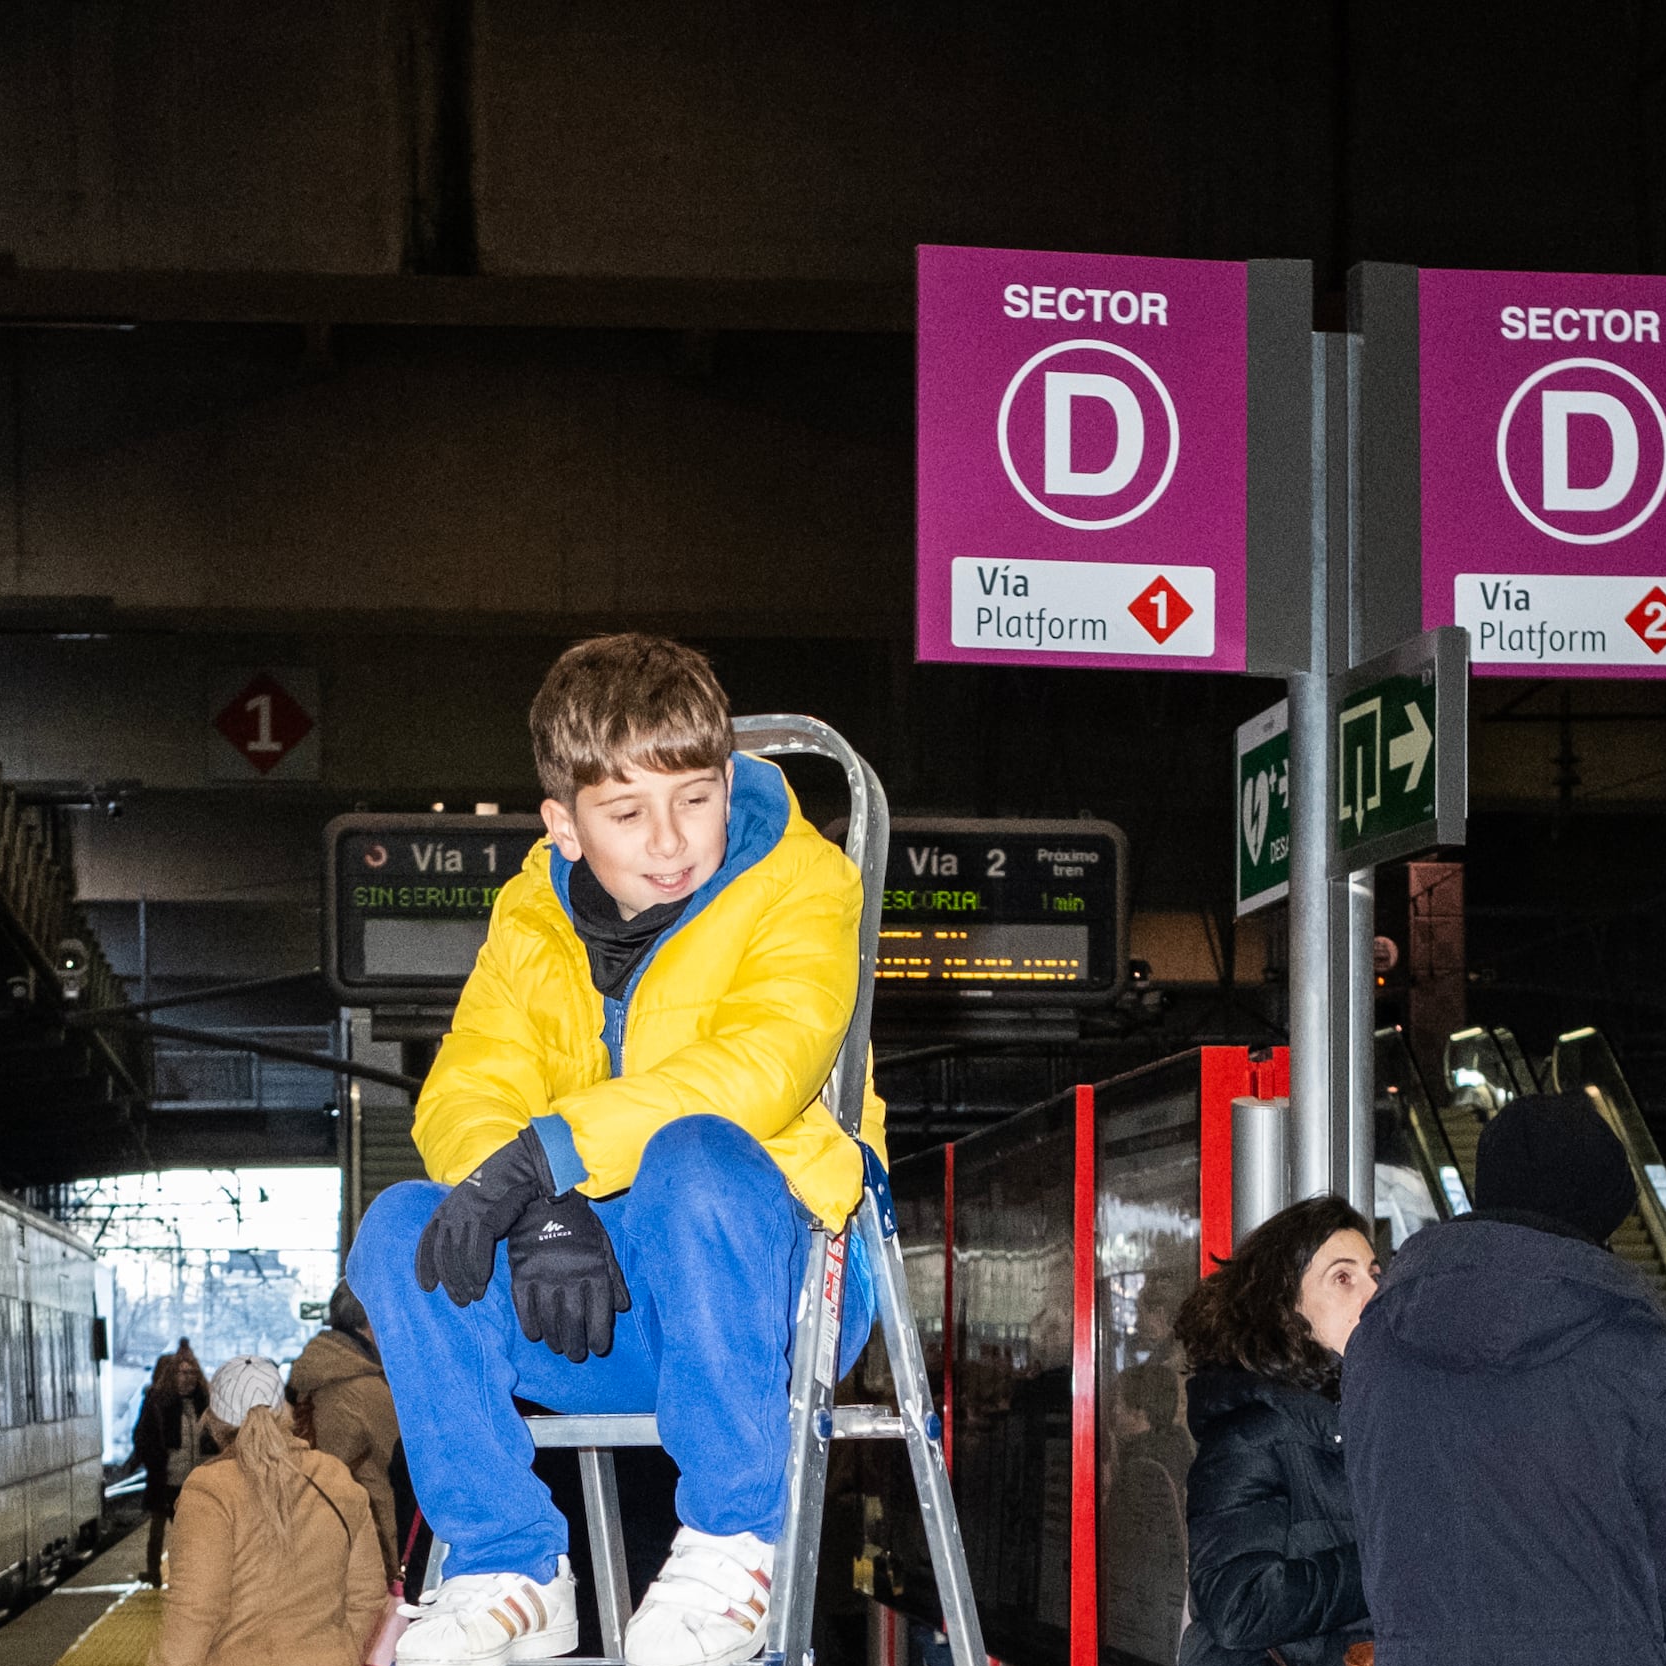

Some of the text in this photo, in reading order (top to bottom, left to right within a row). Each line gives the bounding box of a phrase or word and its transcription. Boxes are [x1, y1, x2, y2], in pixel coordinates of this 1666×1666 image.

[1003, 284, 1169, 326] SECTOR
[1499, 306, 1660, 344] SECTOR
[1044, 371, 1145, 497] D
[1541, 390, 1639, 512] D
[976, 565, 1030, 597] Vía
[1480, 579, 1531, 612] Vía
[1148, 580, 1169, 630] 1
[975, 604, 1108, 645] Platform
[1479, 620, 1607, 659] Platform
[245, 694, 284, 752] 1
[410, 842, 497, 873] Vía 1
[907, 846, 1007, 877] Vía 2
[1052, 863, 1085, 878] tren
[353, 886, 393, 907] SIN
[1052, 891, 1086, 913] min
